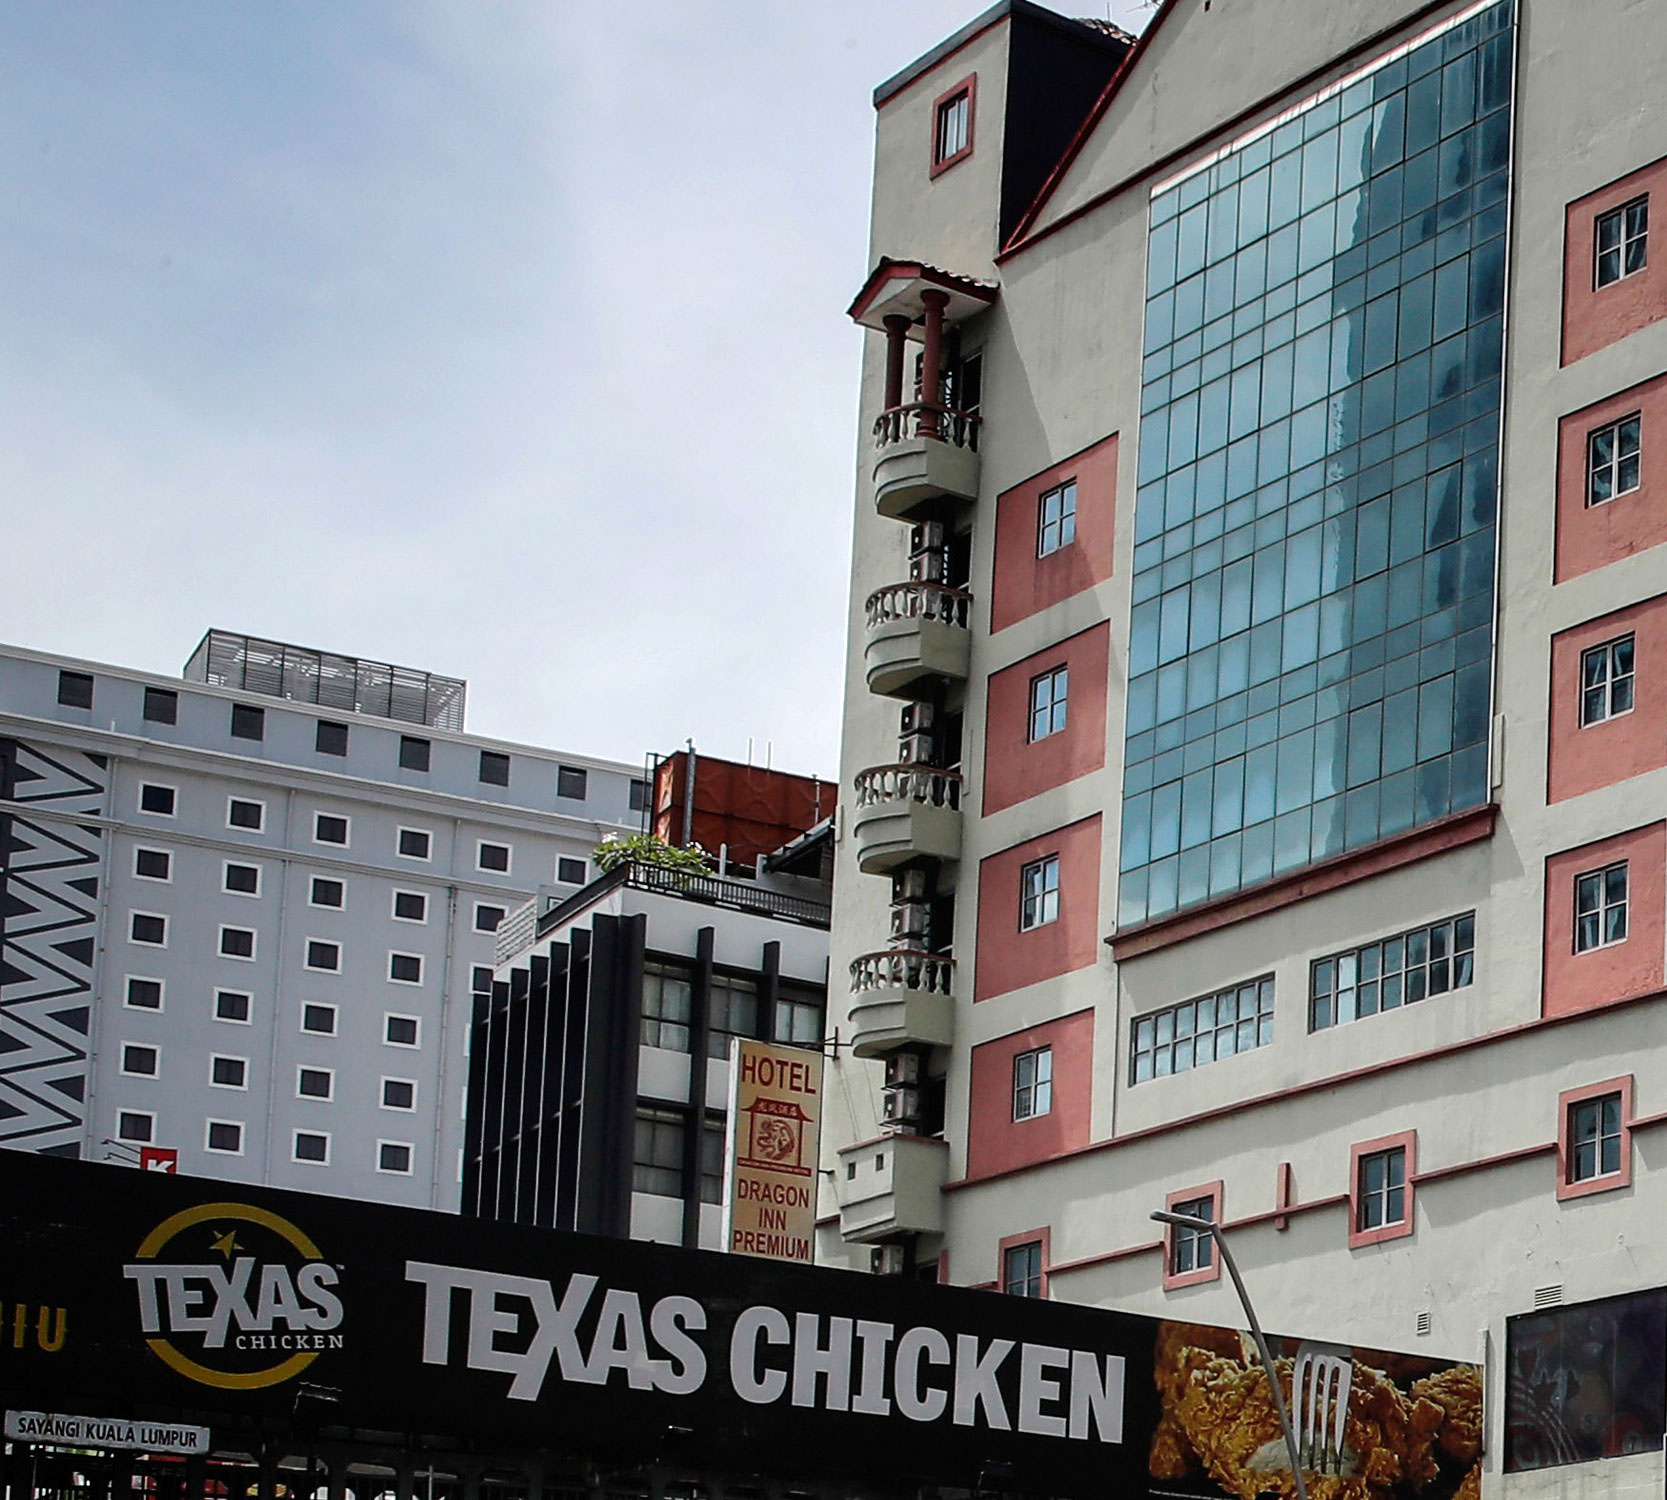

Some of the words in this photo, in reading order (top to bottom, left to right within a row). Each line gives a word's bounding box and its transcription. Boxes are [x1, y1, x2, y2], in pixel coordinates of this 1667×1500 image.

[742, 1054, 816, 1094] HOTEL
[738, 1179, 809, 1208] DRAGON
[759, 1207, 786, 1231] INN
[733, 1230, 809, 1260] PREMIUM
[122, 1257, 344, 1348] TEXAS
[236, 1335, 344, 1349] CHICKEN
[405, 1260, 707, 1401] TEXAS
[730, 1305, 1125, 1444] CHICKEN
[18, 1417, 80, 1438] SAYANGI
[86, 1424, 135, 1442] KUALA
[141, 1428, 197, 1447] LUMPUR
